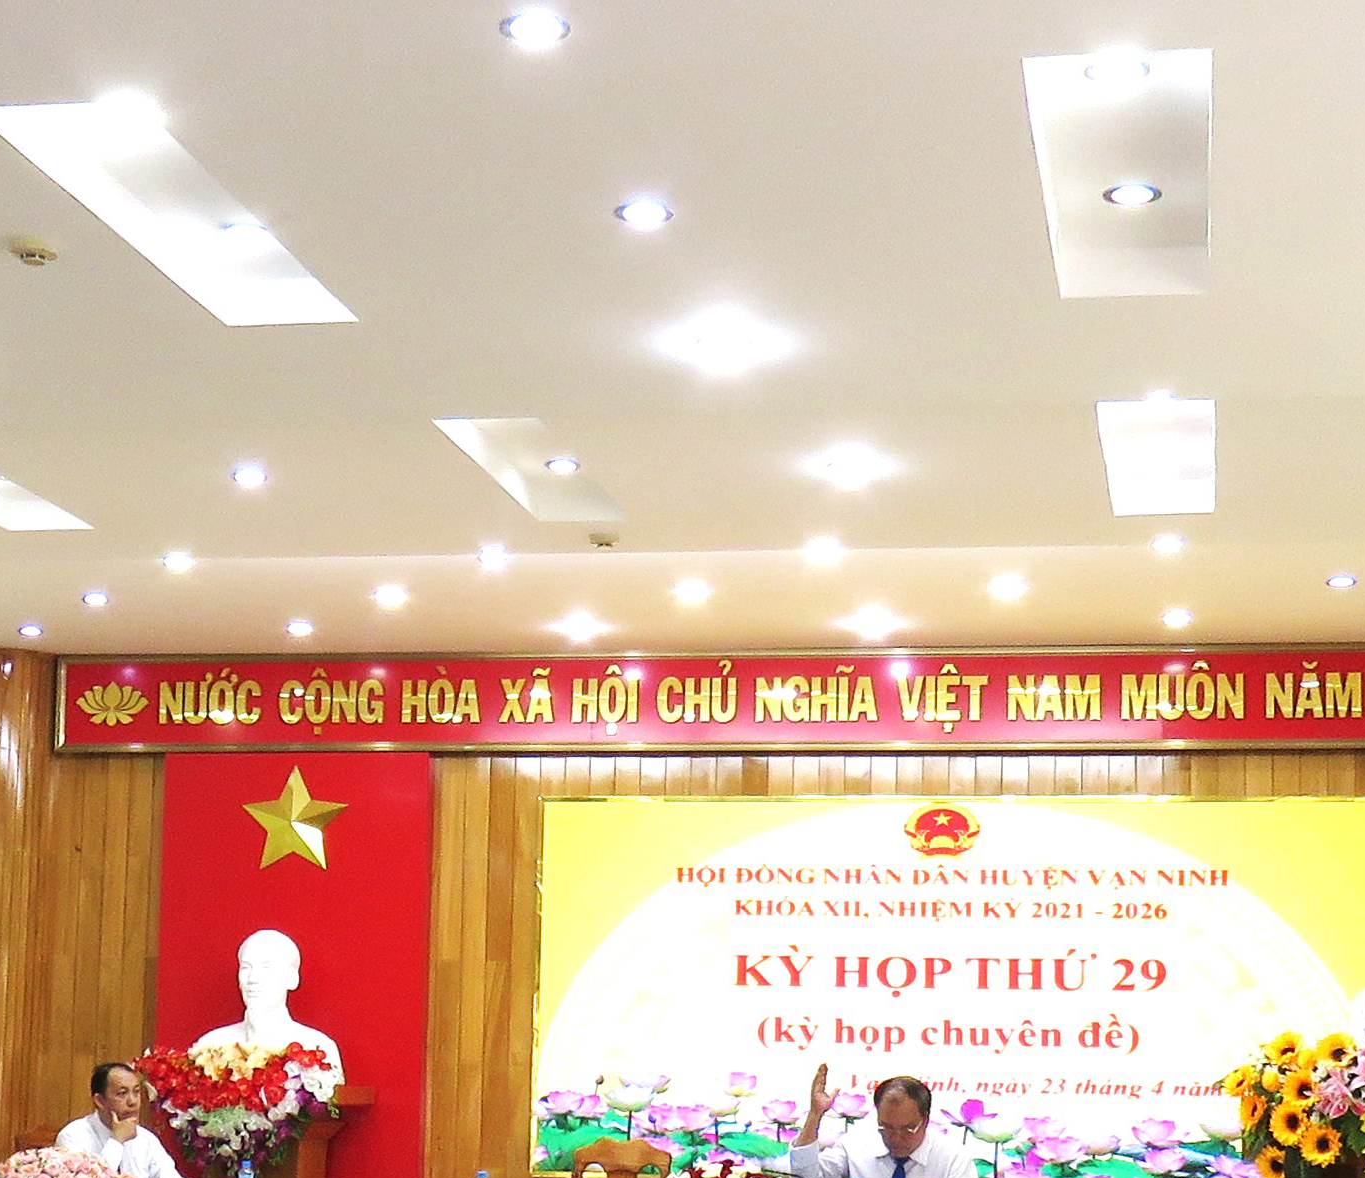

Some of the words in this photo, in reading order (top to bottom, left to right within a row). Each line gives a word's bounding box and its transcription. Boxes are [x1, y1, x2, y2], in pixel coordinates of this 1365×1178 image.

[159, 669, 261, 726] NƯỚC
[279, 669, 386, 735] CỘNG
[401, 666, 481, 724] HÒA
[499, 667, 554, 724] XÃ
[572, 664, 639, 736] HỘI
[656, 660, 736, 723] CHỦ
[754, 663, 879, 723] NGHĨA
[897, 664, 989, 734] VIỆT
[1007, 672, 1102, 721] NAM
[1120, 660, 1245, 721] MUÔN
[677, 865, 726, 888] HỘI
[735, 863, 815, 884] ĐỒNG
[823, 864, 902, 884] NHÂN
[912, 864, 969, 885] DÂN
[980, 867, 1078, 890] HUYỆN
[1087, 869, 1147, 891] VẠN
[1157, 869, 1229, 887] NINH
[735, 896, 815, 917] KHÓA
[823, 900, 869, 919] XII,
[878, 899, 972, 922] NHIỆM
[983, 898, 1022, 919] KỲ
[1031, 902, 1083, 919] 2021
[1111, 902, 1168, 919] 2026
[734, 944, 815, 987] KỲ
[834, 956, 953, 998] HỌP
[965, 948, 1098, 991] THỨ
[1111, 958, 1167, 991] 29
[757, 1016, 819, 1051] (kỳ
[834, 1018, 906, 1053] họp
[920, 1019, 1062, 1055] chuyên
[1077, 1013, 1140, 1055] đề)
[976, 1078, 1032, 1099] ngày
[1041, 1078, 1066, 1095] 23
[1074, 1078, 1143, 1099] tháng
[1151, 1080, 1164, 1096] 4
[1173, 1081, 1223, 1097] năm
